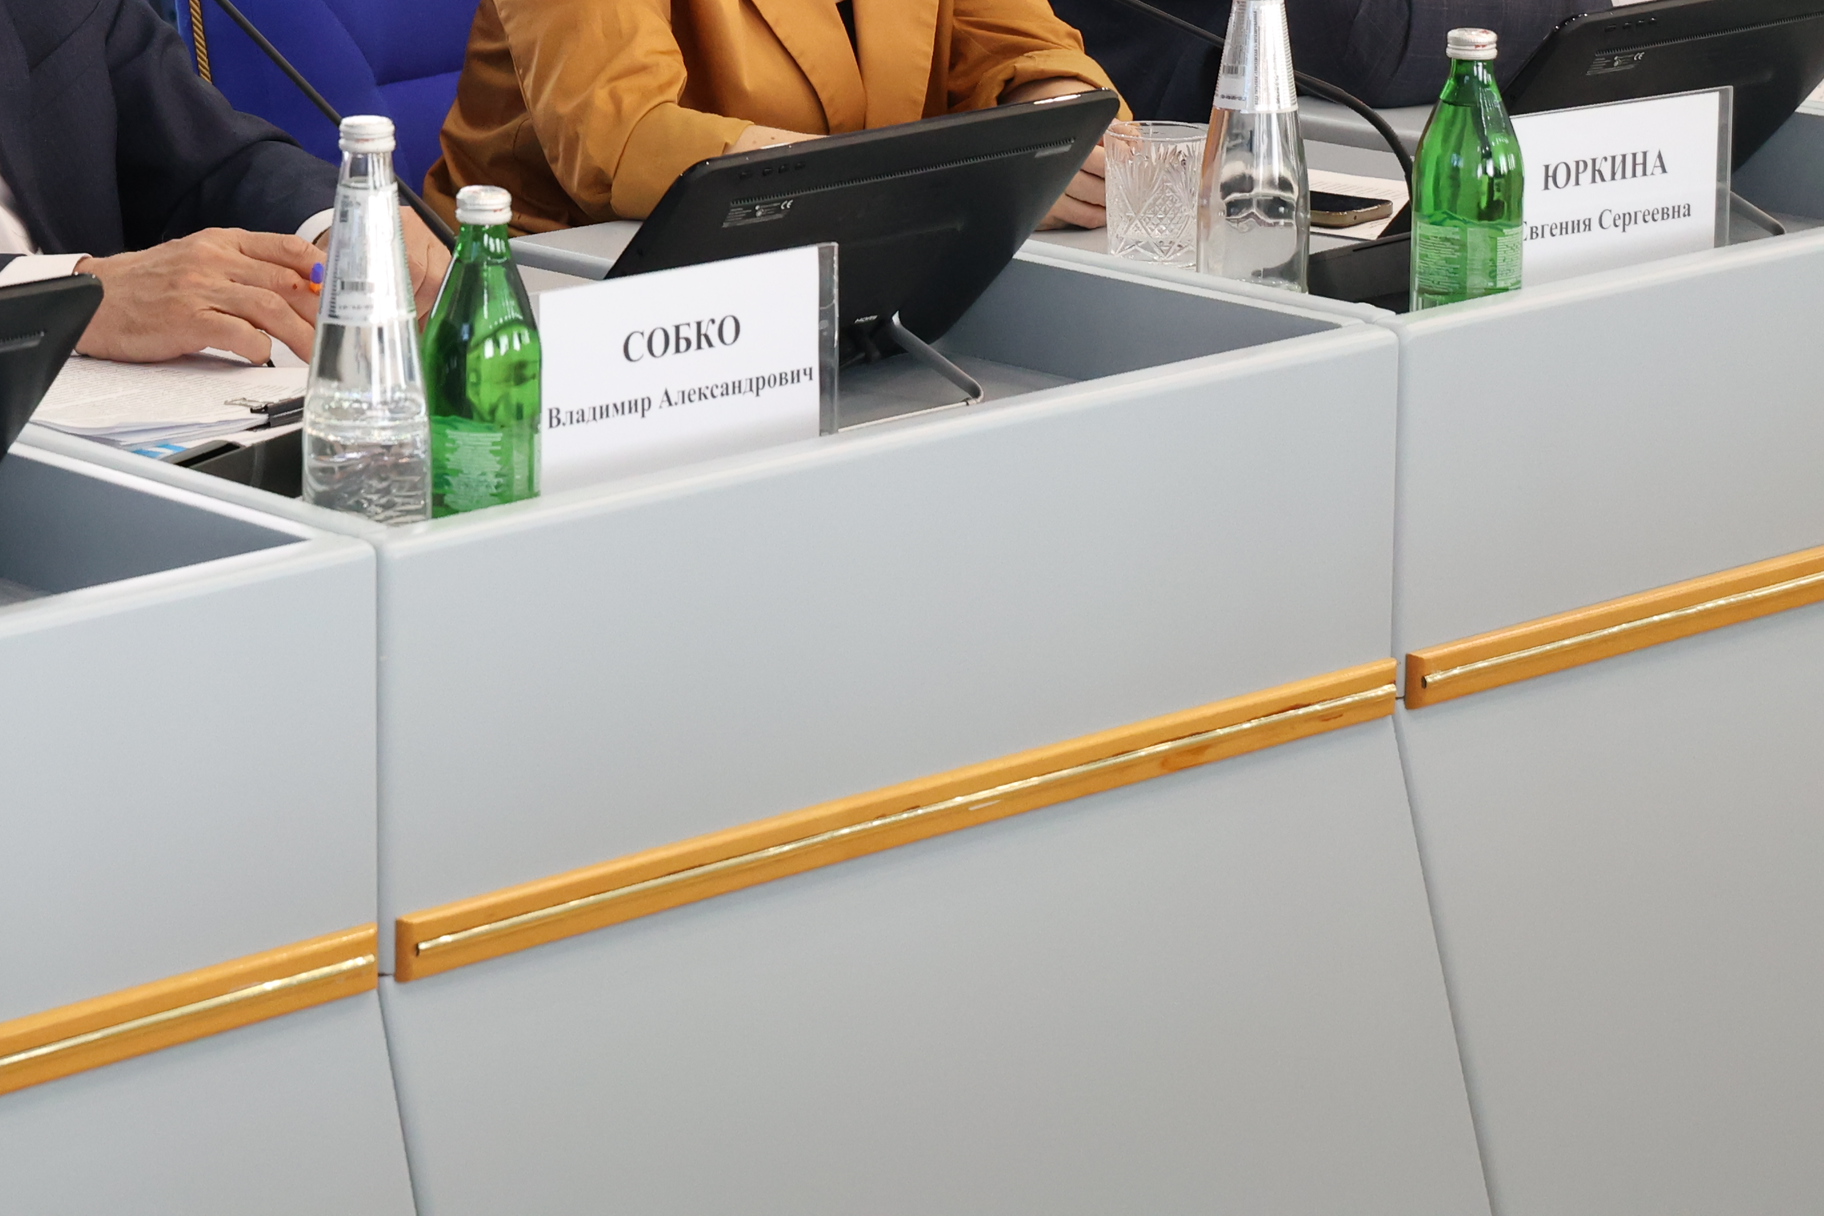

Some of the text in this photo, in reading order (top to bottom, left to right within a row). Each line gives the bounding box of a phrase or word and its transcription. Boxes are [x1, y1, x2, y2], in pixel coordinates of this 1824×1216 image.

[1541, 148, 1669, 191] ЮРКИНА
[1598, 202, 1692, 233] Сергеевна
[622, 314, 741, 363] СОБКО
[547, 366, 815, 430] Владимир Александрович
